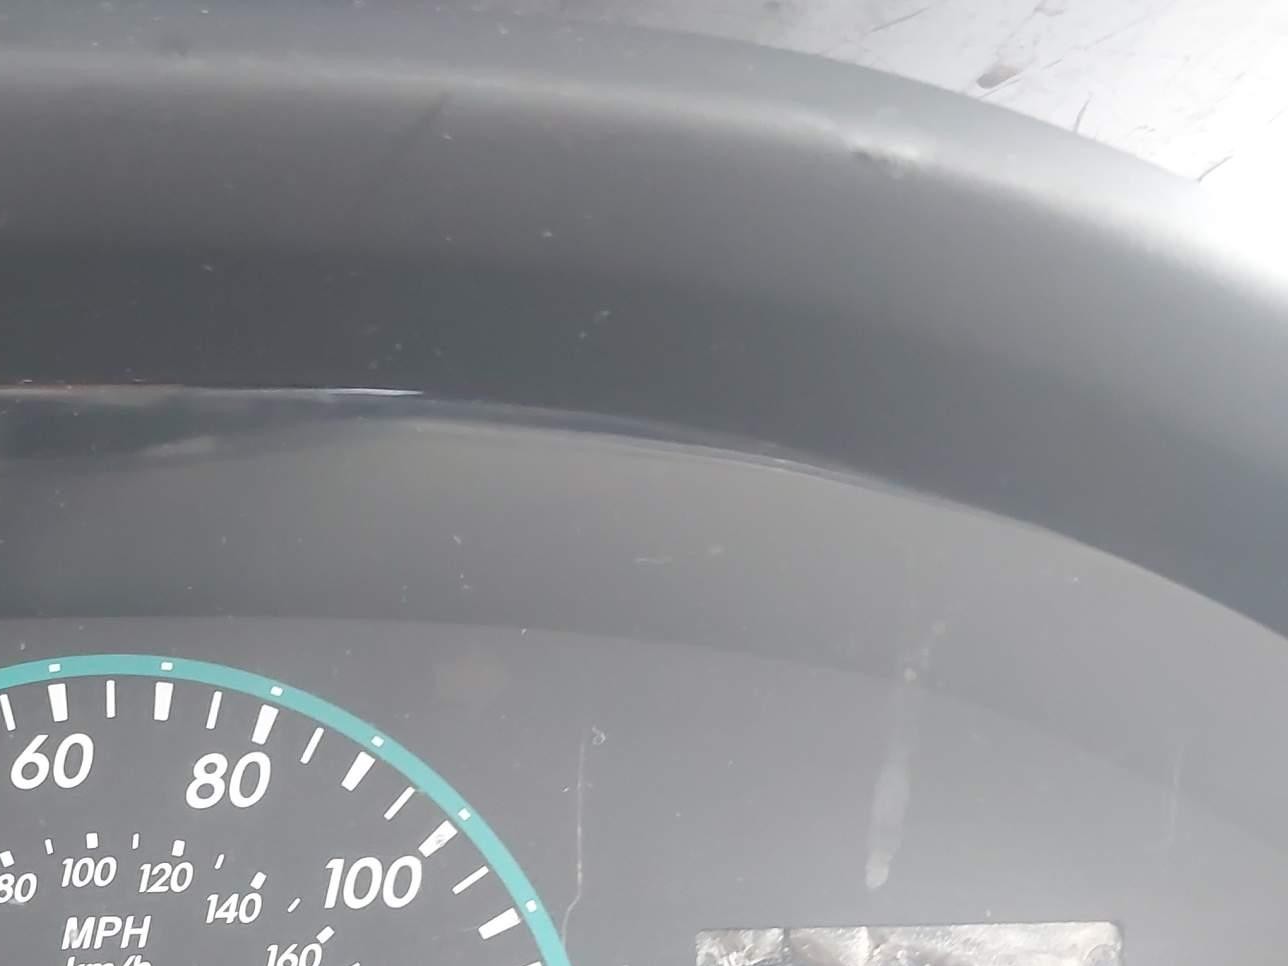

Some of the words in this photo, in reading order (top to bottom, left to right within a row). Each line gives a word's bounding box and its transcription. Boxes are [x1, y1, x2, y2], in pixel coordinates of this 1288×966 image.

[10, 733, 94, 789] 60
[186, 752, 271, 809] 80
[61, 856, 117, 887] 100
[138, 863, 194, 893] 120
[323, 856, 422, 909] 100
[205, 892, 263, 924] 140
[61, 915, 151, 949] MPH
